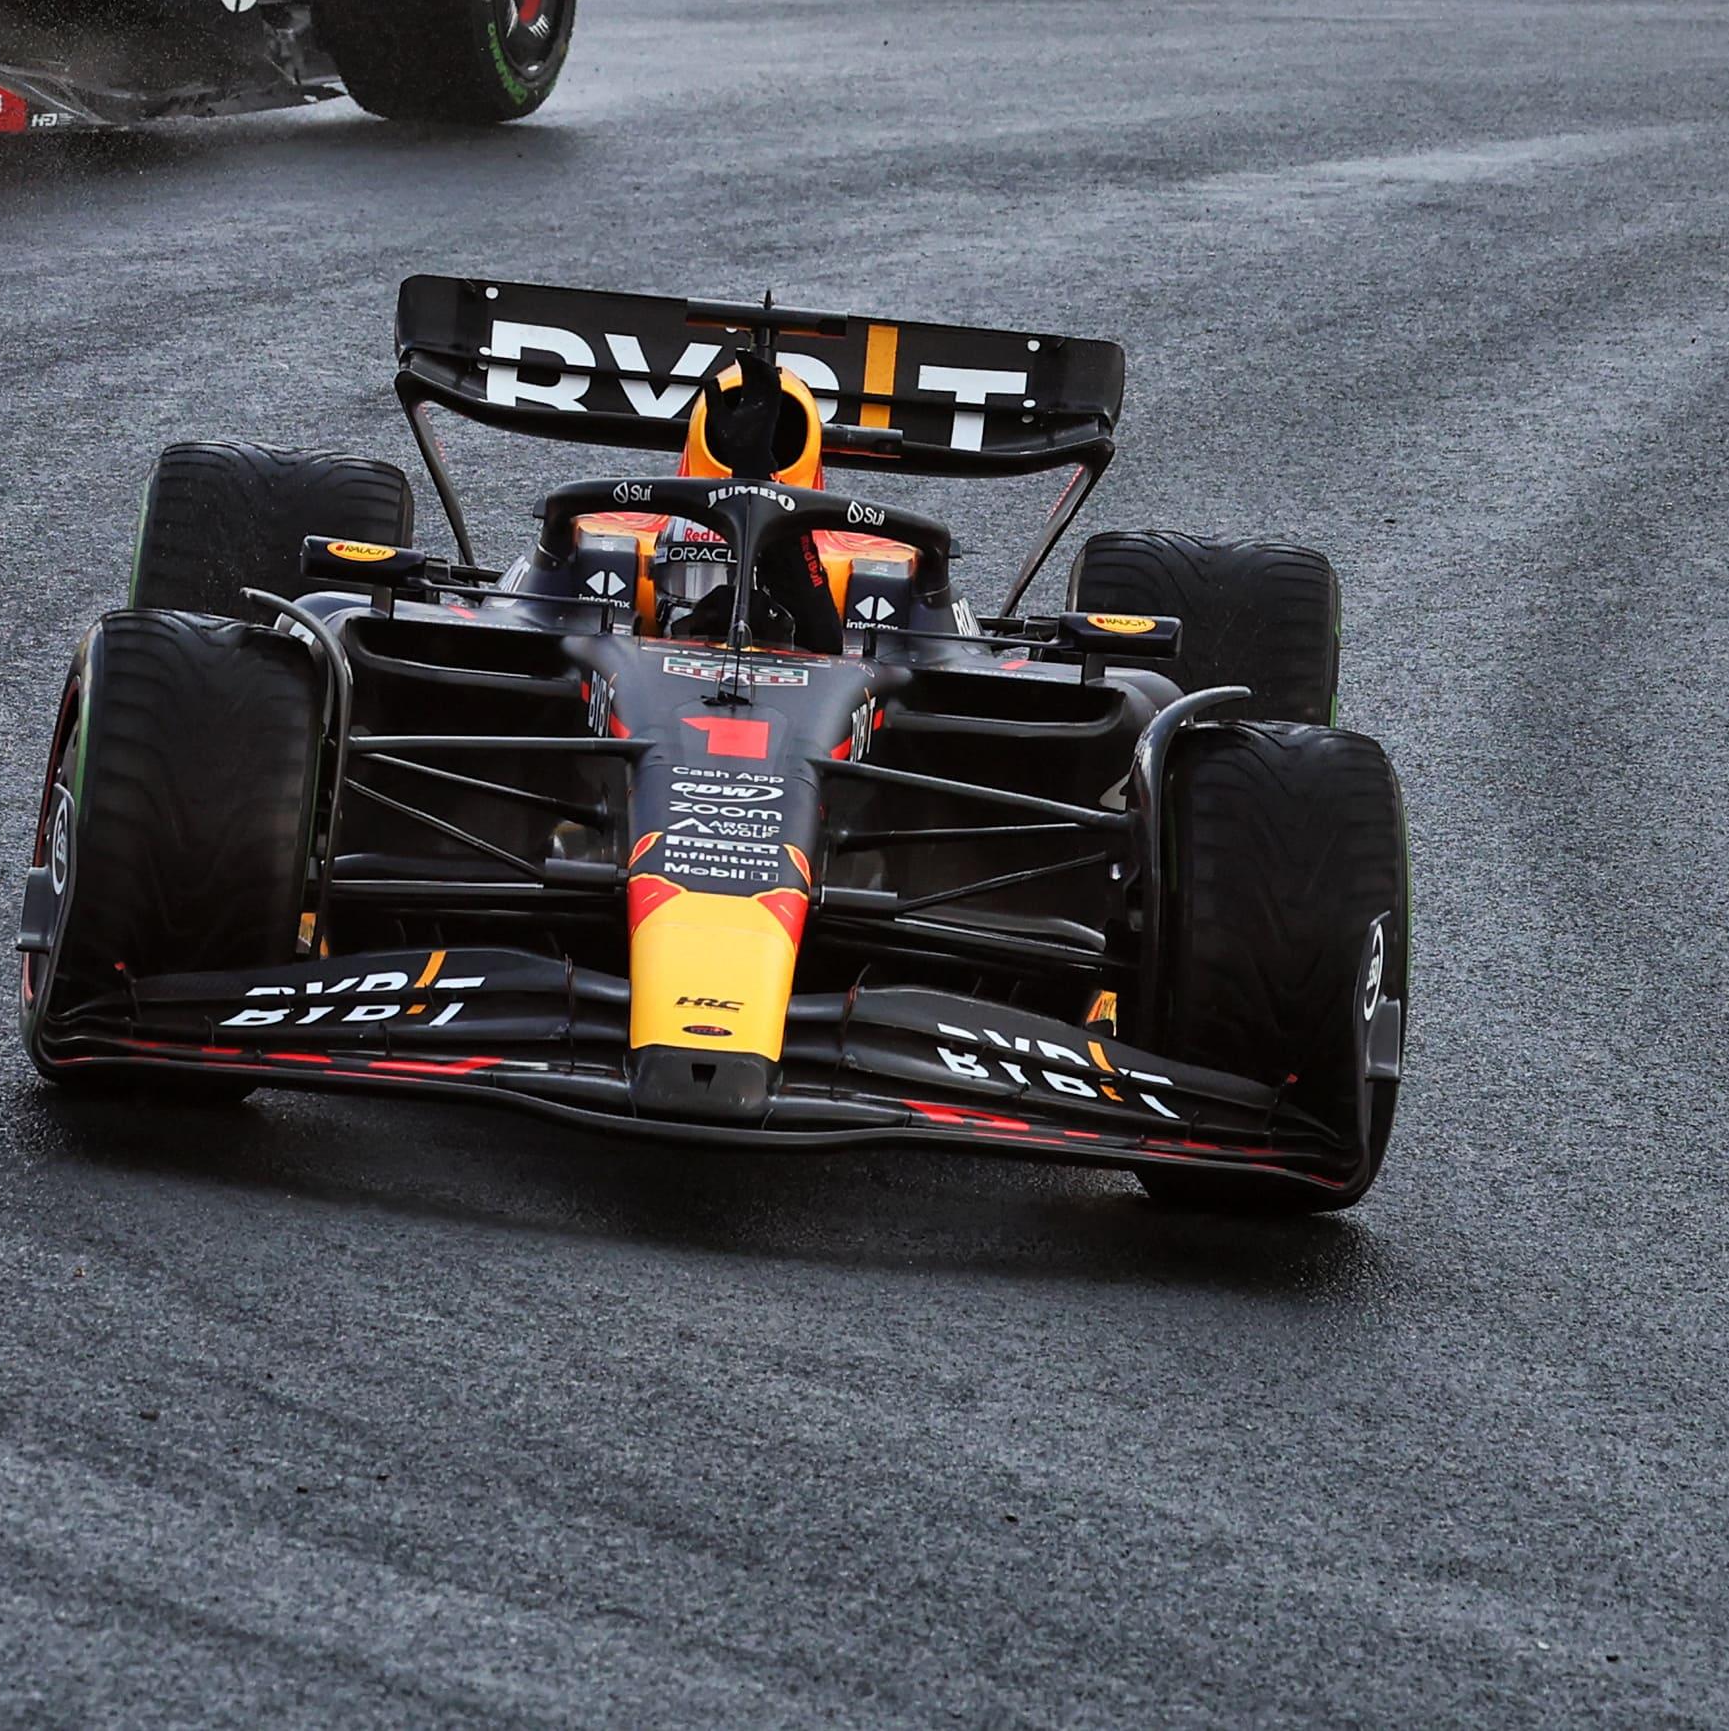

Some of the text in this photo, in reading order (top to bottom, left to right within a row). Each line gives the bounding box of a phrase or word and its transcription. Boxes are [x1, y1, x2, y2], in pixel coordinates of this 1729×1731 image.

[630, 483, 653, 503] Sui
[707, 485, 796, 511] JUMBO
[864, 507, 885, 527] Sui
[684, 527, 710, 543] Red
[344, 544, 387, 557] RAUCH
[668, 546, 738, 563] ORACL
[680, 716, 769, 760] 1
[672, 766, 785, 784] Cash App
[671, 781, 760, 799] CDW
[668, 801, 783, 821] zoom
[709, 820, 780, 834] ARCTIC
[718, 828, 773, 839] WOLF
[664, 849, 779, 868] Infinitum
[664, 862, 745, 879] Mobil
[674, 996, 744, 1011] HRC
